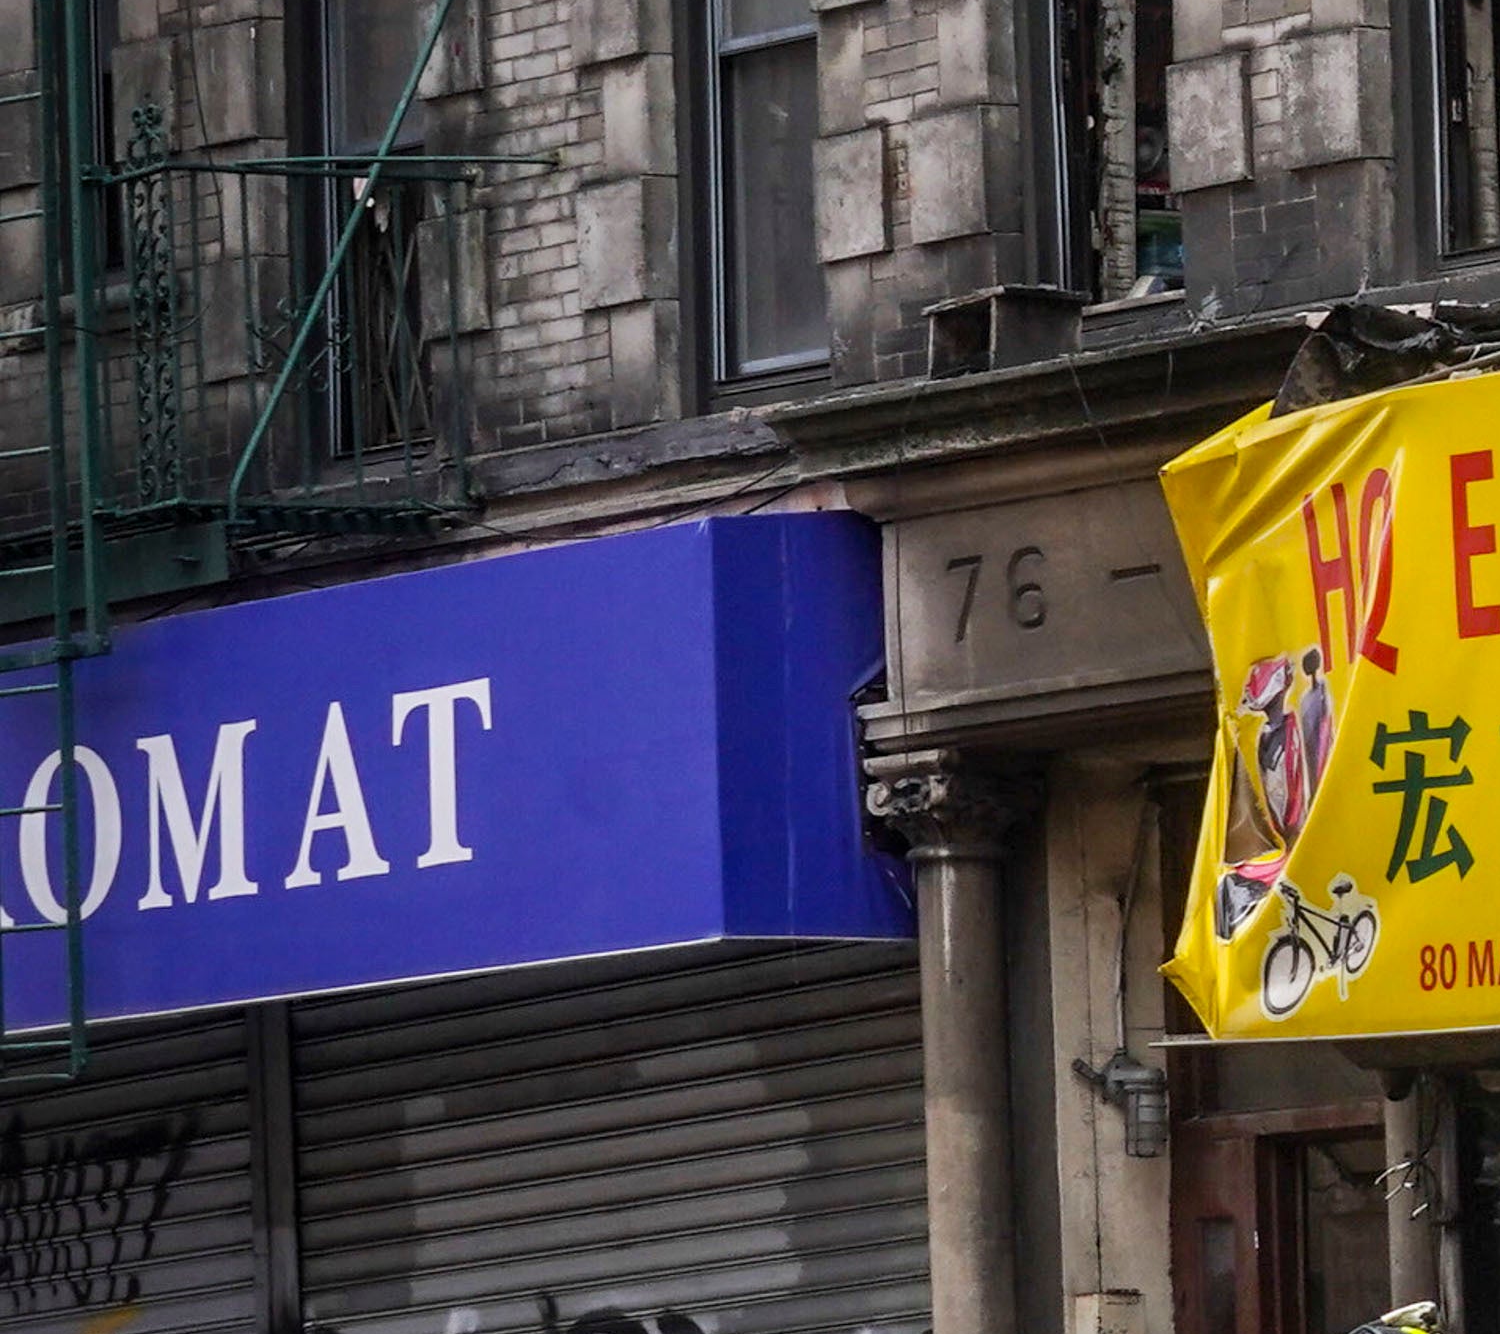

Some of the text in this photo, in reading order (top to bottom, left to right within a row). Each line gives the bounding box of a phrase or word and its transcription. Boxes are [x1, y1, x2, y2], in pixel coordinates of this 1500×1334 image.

[946, 545, 1047, 642] 76
[1302, 468, 1398, 676] HQ
[1419, 942, 1458, 992] 80
